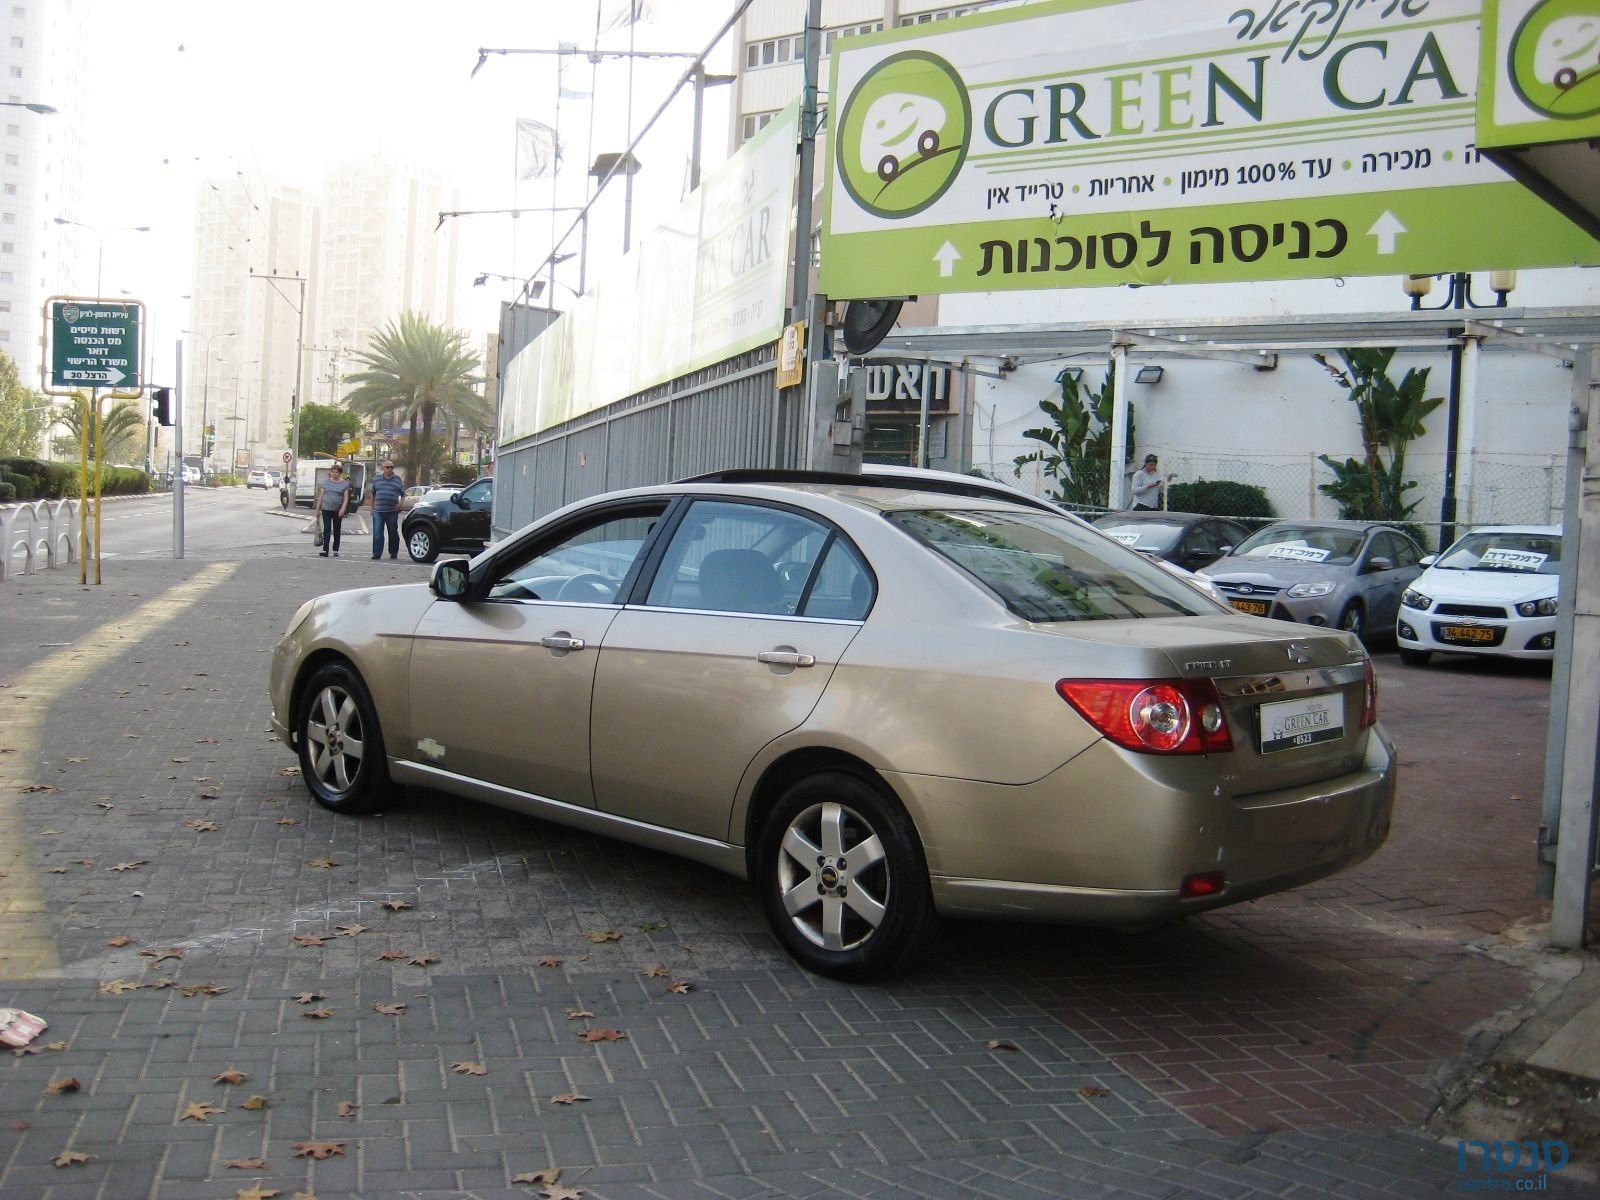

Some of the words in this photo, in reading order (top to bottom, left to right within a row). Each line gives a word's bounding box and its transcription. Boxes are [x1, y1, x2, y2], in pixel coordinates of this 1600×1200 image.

[984, 55, 1270, 147] GREEN
[1323, 31, 1479, 110] CA
[1301, 157, 1332, 179] עד
[1362, 148, 1431, 174] מכירה
[1180, 167, 1229, 195] מימון
[1237, 161, 1296, 185] 100%
[1015, 182, 1064, 202] טרייד
[1088, 174, 1155, 198] אחריות
[987, 185, 1010, 209] אין
[730, 206, 771, 279] CAR
[976, 221, 1171, 277] לסוכנות
[1189, 218, 1348, 265] כניסה
[70, 326, 98, 334] מיסים
[100, 327, 126, 335] רשות
[73, 336, 104, 345] הכנסה
[107, 337, 122, 345] מס
[86, 347, 109, 356] דואר
[100, 358, 128, 366] משרד
[70, 371, 82, 379] 30
[85, 371, 107, 380] הרצל
[1273, 547, 1325, 559] למכירה
[1485, 551, 1543, 564] למכירה
[1284, 714, 1311, 731] GREEN
[1313, 711, 1328, 725] CAR
